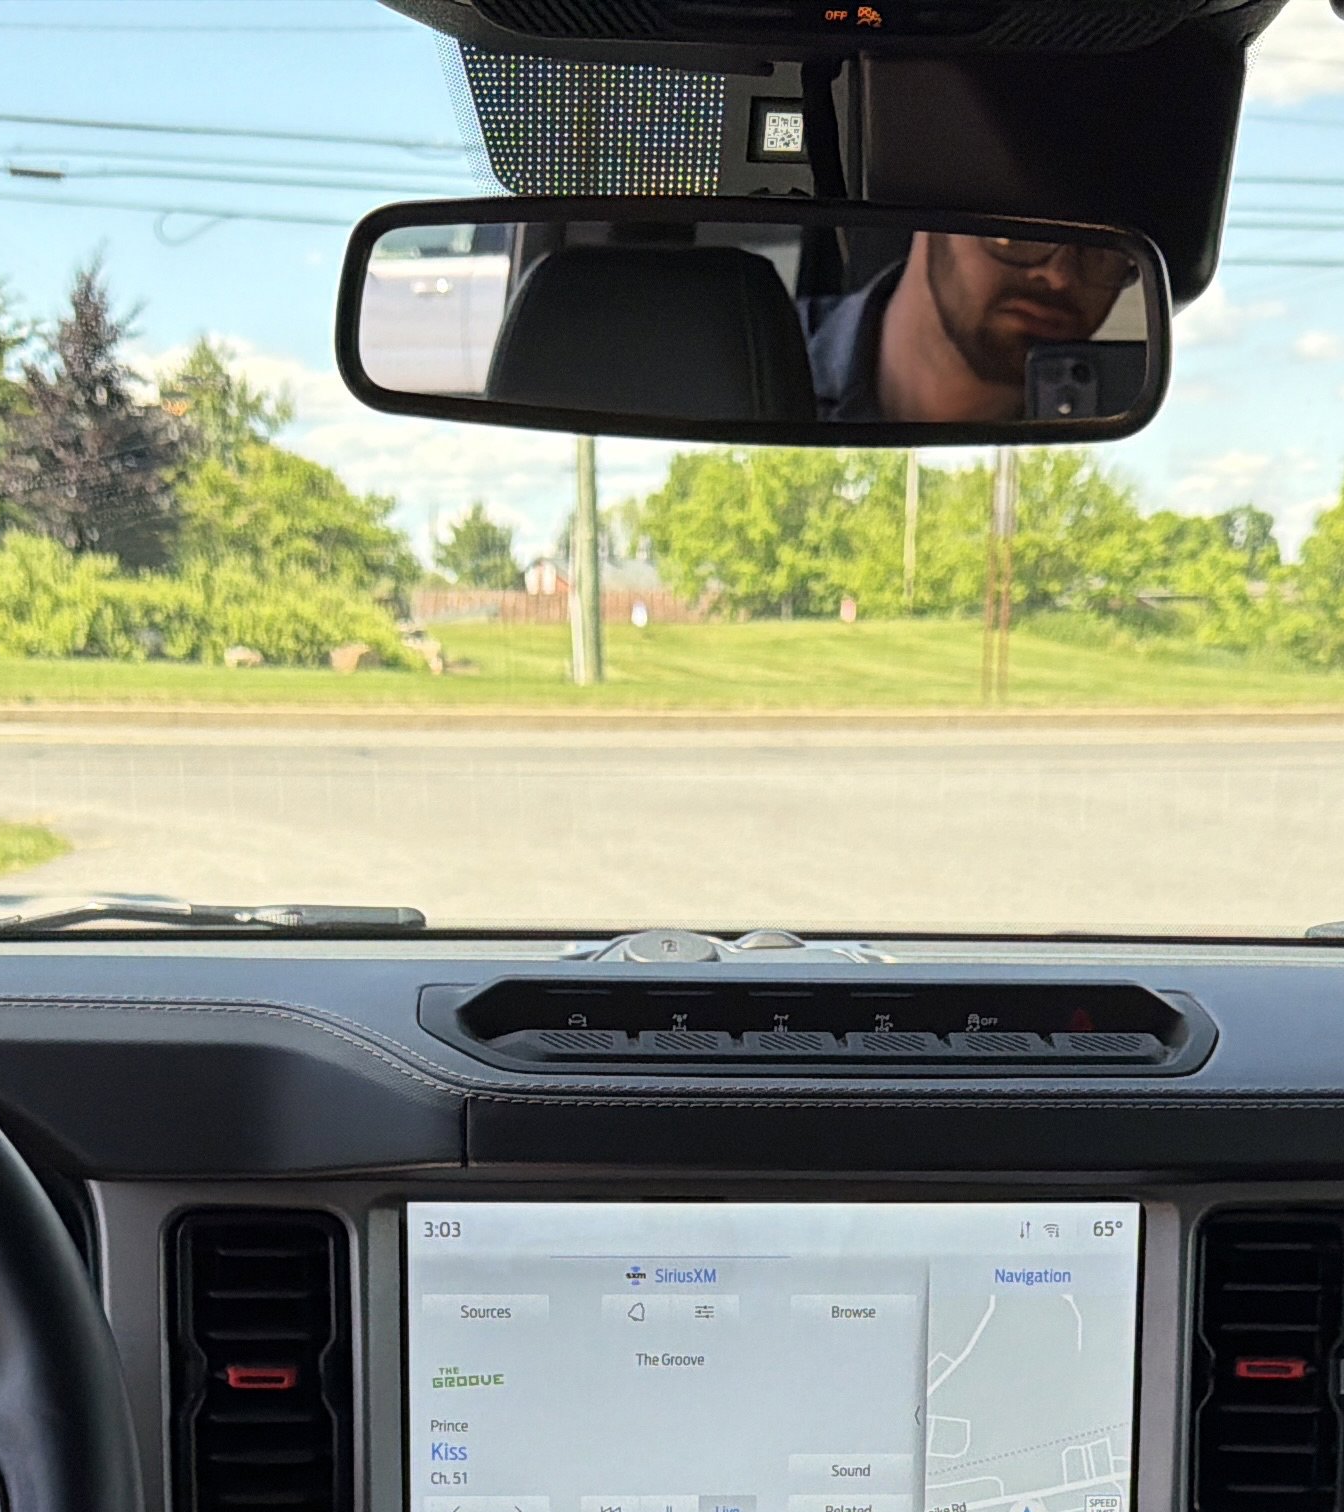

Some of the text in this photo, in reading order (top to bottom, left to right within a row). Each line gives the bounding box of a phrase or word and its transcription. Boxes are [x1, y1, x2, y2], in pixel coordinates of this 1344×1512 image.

[825, 9, 847, 20] OFF
[980, 1017, 998, 1026] OFF
[424, 1221, 461, 1238] 3:03
[655, 1268, 716, 1284] SiriusXM
[994, 1268, 1071, 1286] Navigation
[460, 1305, 512, 1319] Sources
[831, 1306, 876, 1319] Browse
[636, 1353, 705, 1367] The Groove
[438, 1367, 460, 1375] THE
[432, 1373, 505, 1389] GROOVE
[430, 1419, 469, 1433] Prince
[430, 1442, 468, 1461] Kiss
[831, 1464, 871, 1477] Sound
[430, 1472, 468, 1485] Ch. 51
[1089, 1498, 1117, 1507] SPEED
